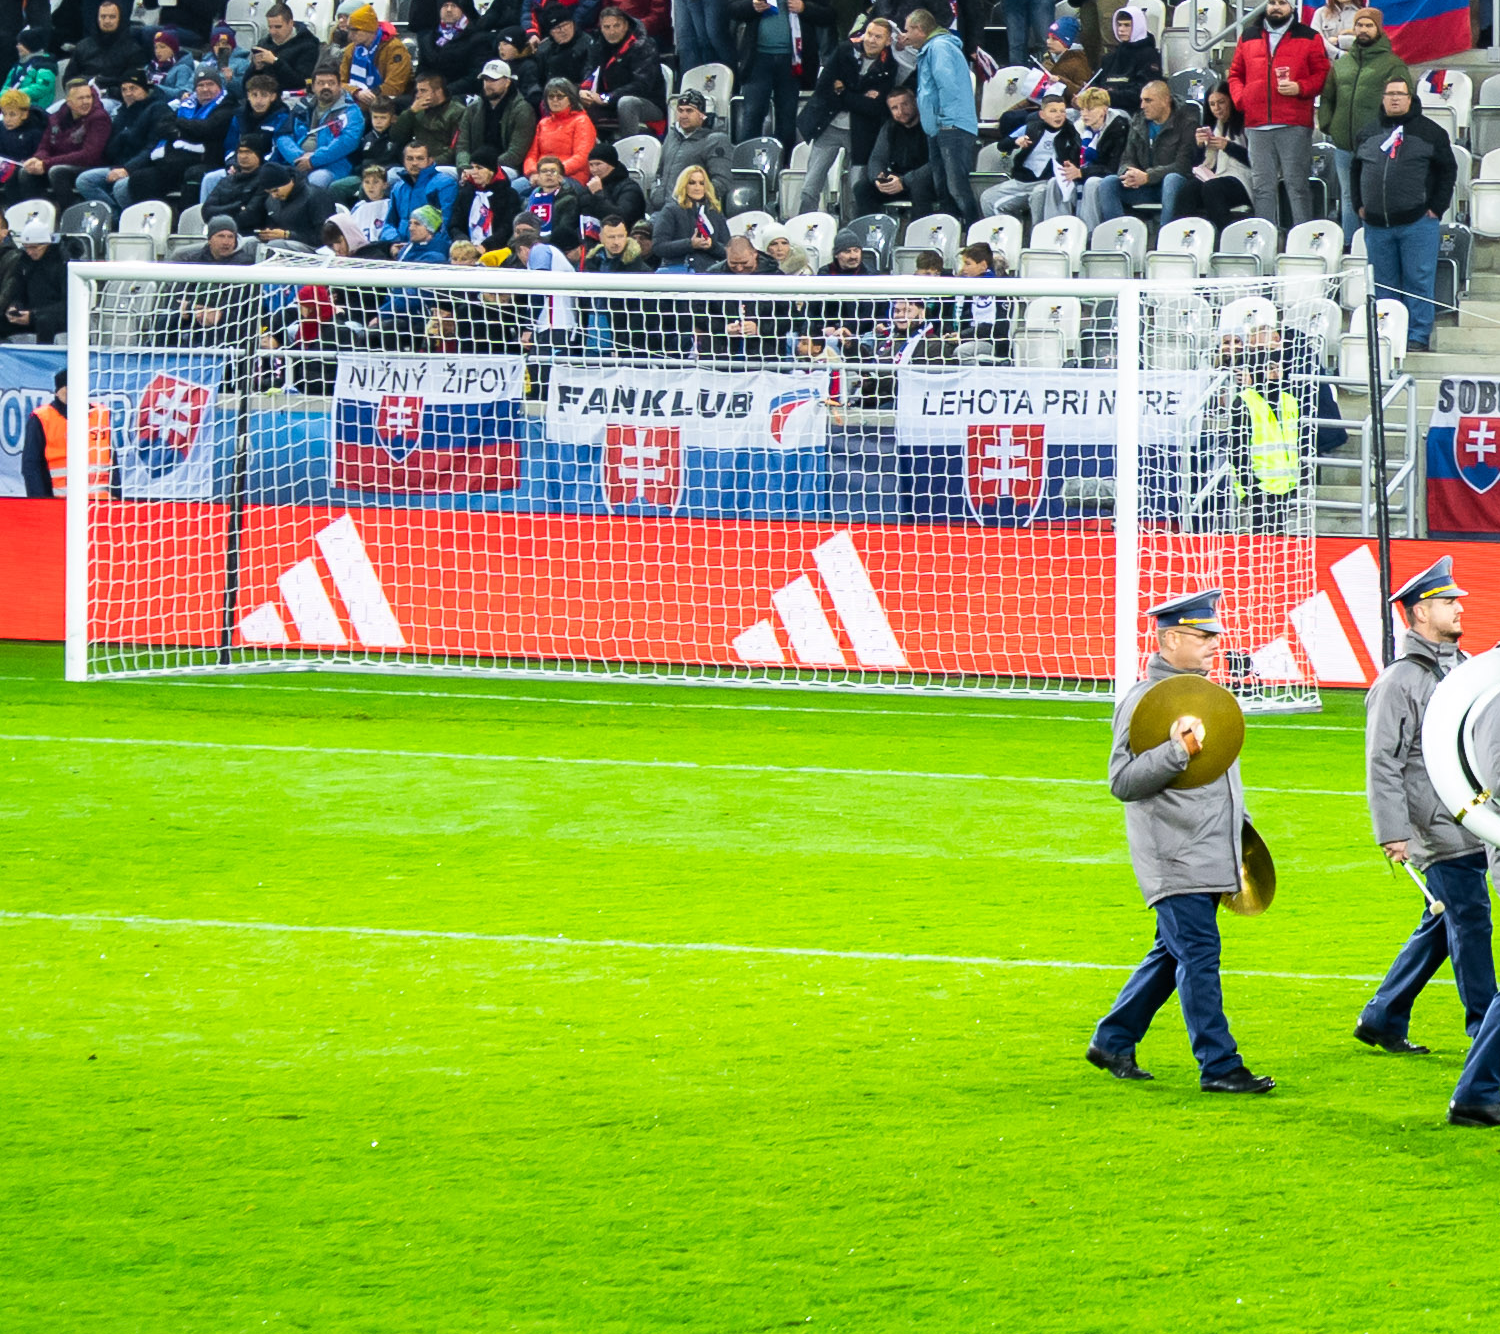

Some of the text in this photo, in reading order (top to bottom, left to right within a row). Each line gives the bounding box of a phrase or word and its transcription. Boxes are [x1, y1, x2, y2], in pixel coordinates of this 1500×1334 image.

[348, 360, 517, 394] NIŽNÝ ŽIPOV
[557, 384, 753, 419] FANKLUB
[921, 389, 1183, 416] LEHOTA PRI NRE
